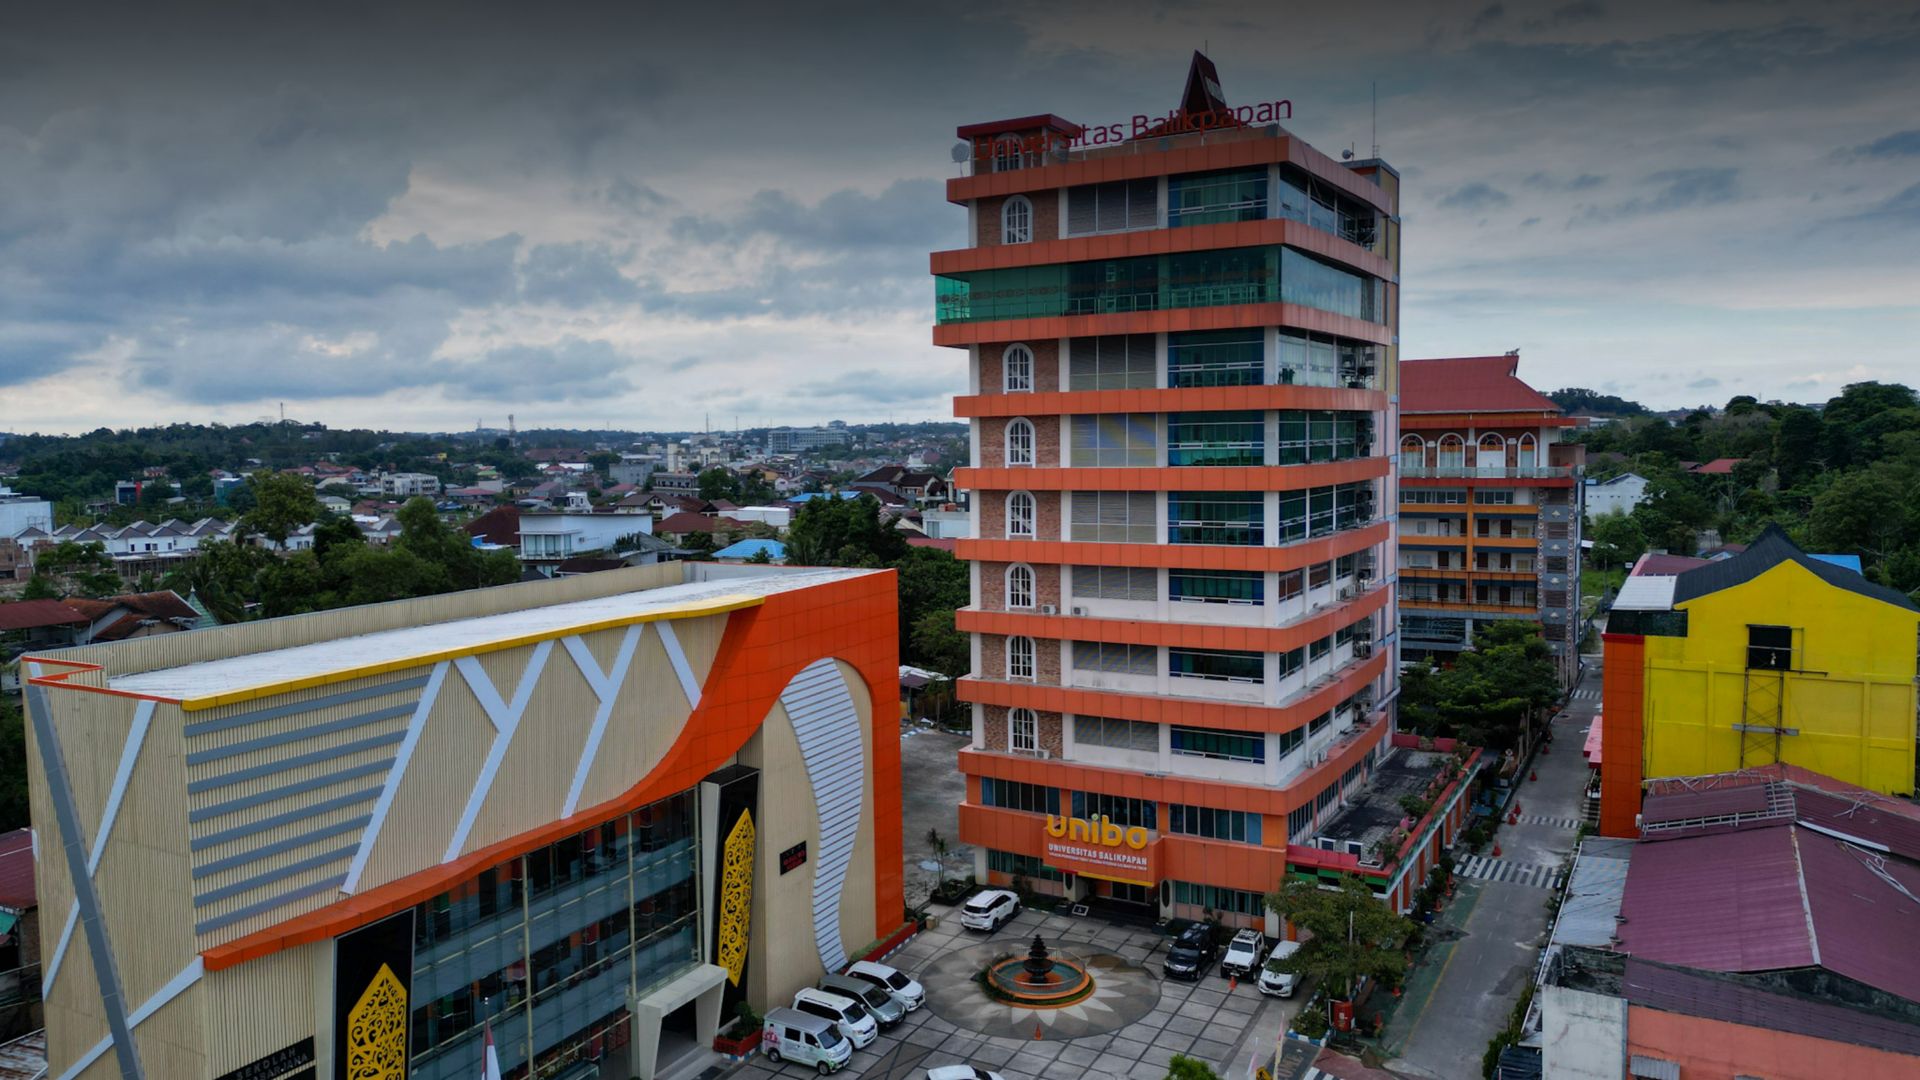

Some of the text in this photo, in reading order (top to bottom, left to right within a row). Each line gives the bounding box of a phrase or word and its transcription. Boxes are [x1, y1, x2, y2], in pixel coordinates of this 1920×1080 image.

[974, 99, 1292, 160] Universitas Balikpapan
[1048, 843, 1097, 859] UNIVERSITAS
[1098, 851, 1147, 866] BALIKPAPAN
